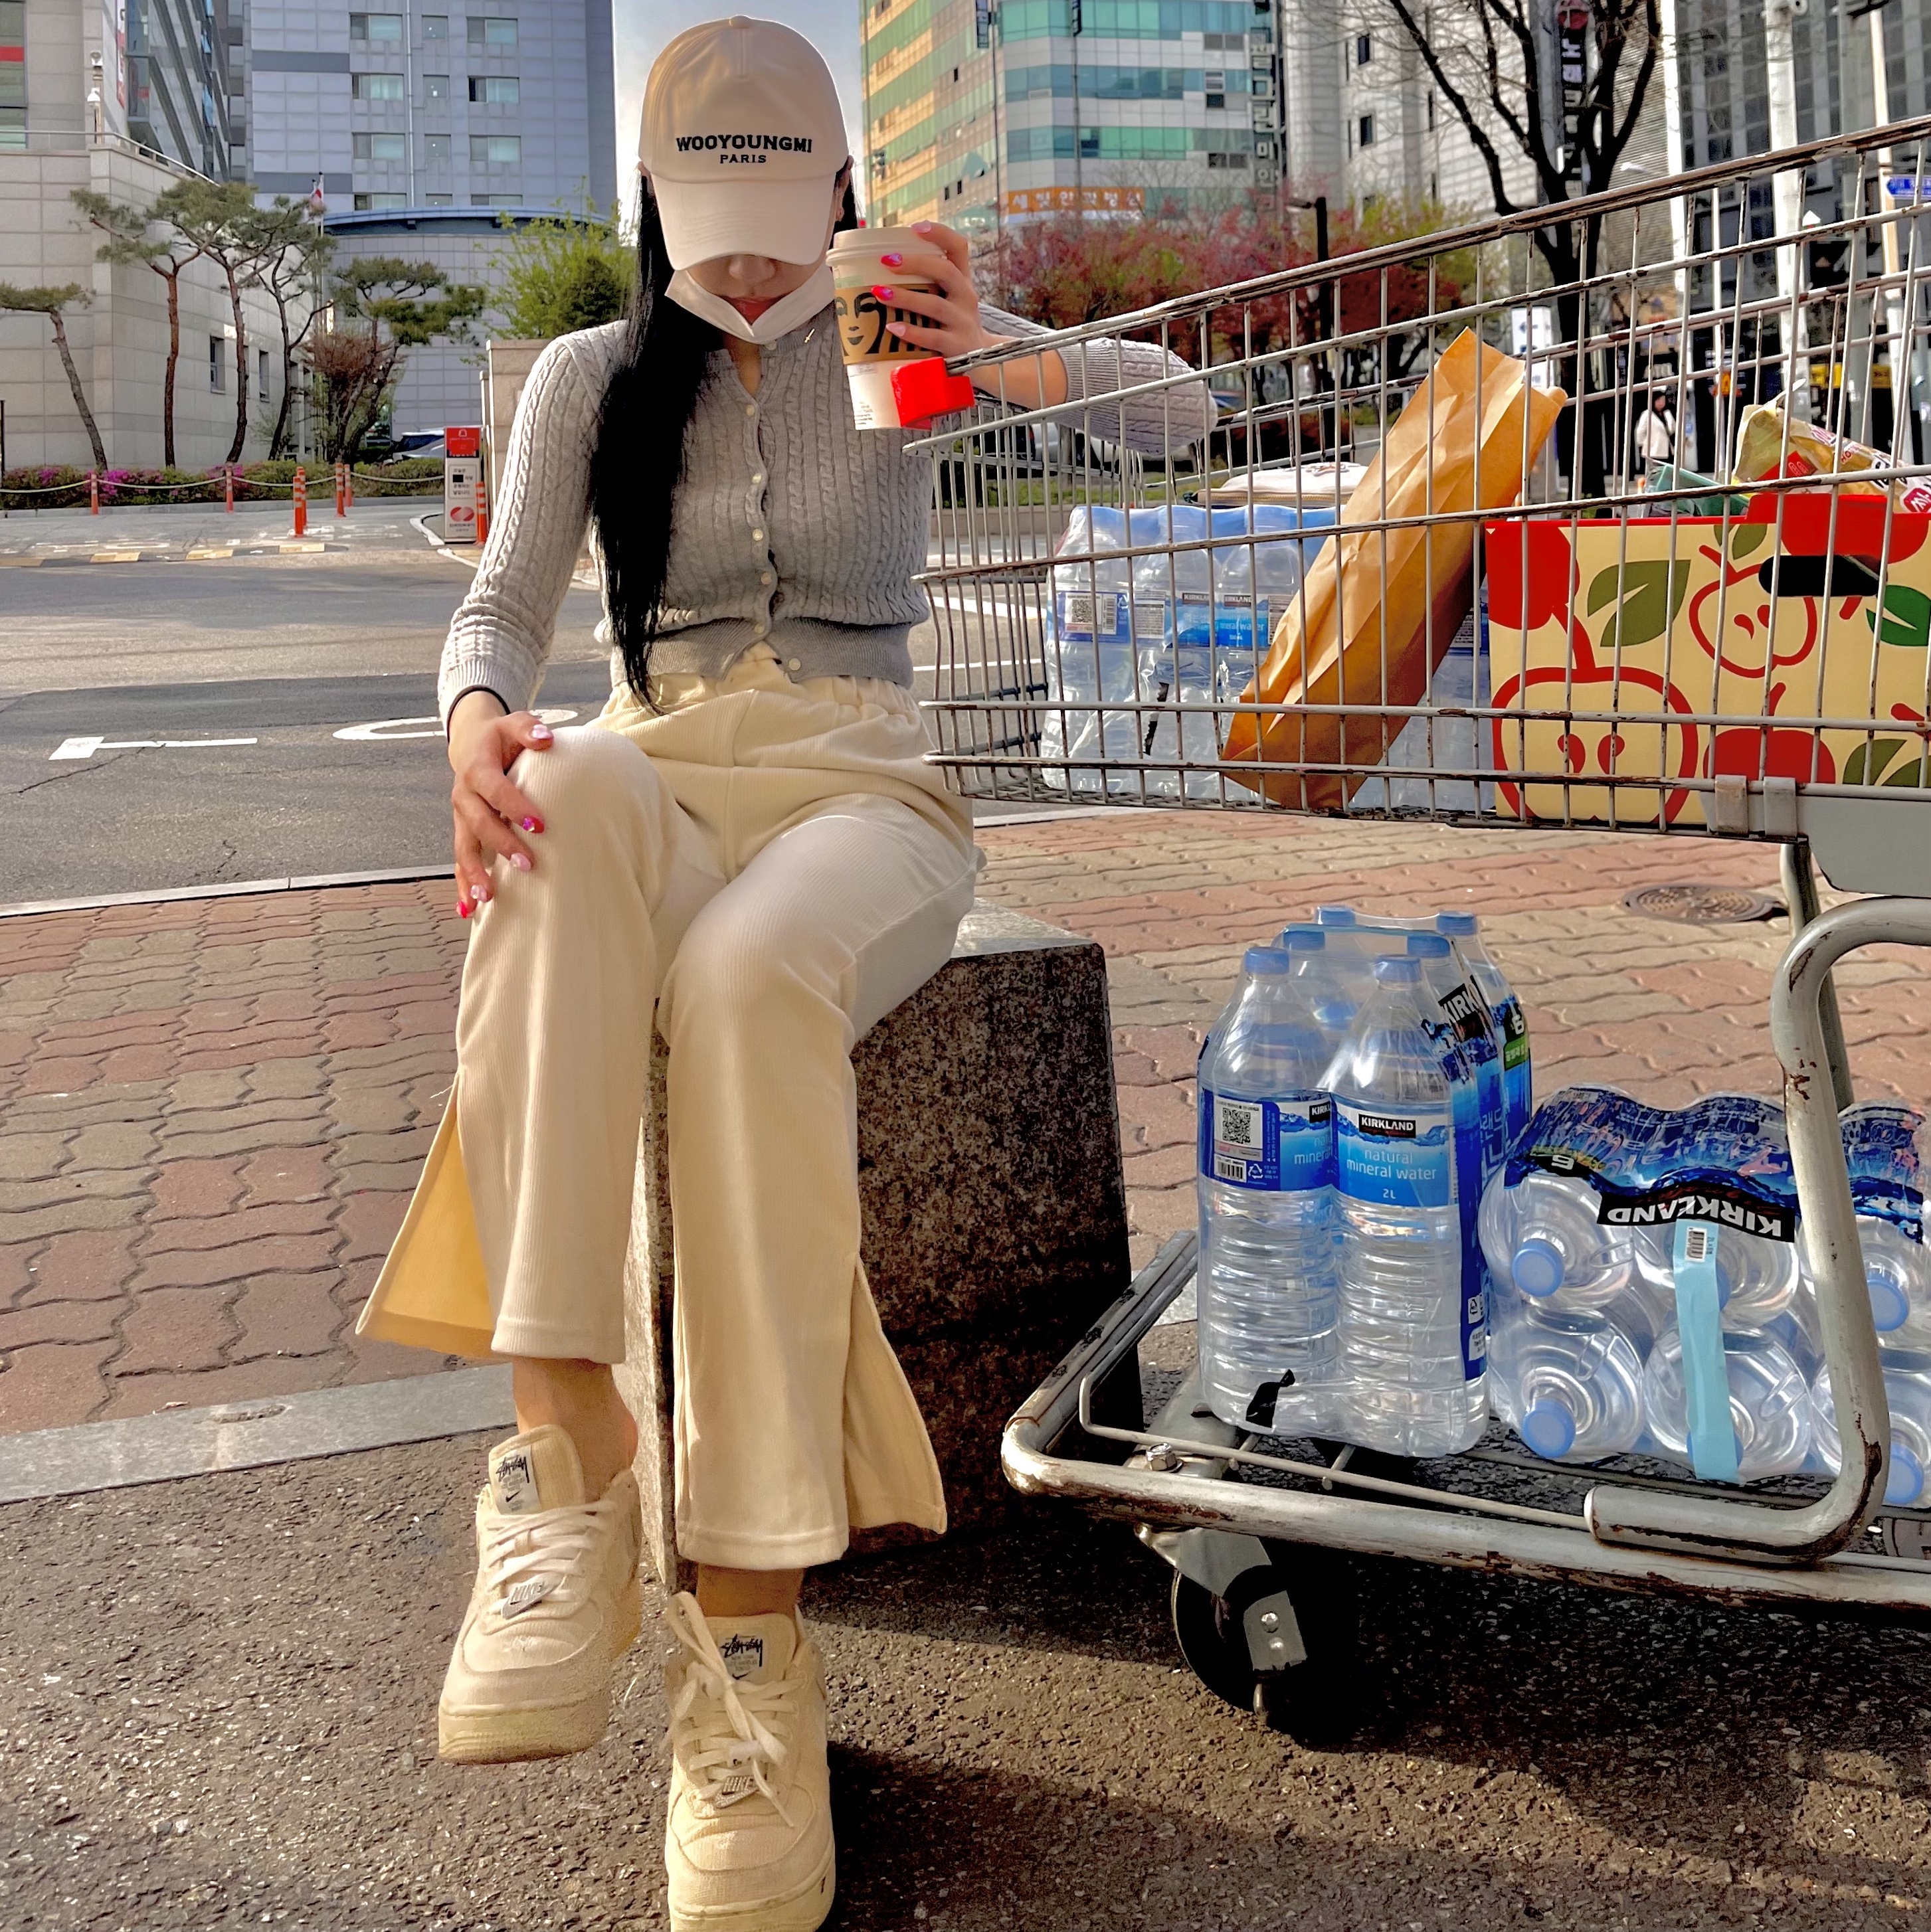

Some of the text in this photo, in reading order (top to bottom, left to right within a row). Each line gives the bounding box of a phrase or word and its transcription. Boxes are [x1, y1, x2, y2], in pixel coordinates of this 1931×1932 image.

[676, 135, 812, 153] WOOYOUNGMI
[720, 154, 767, 163] PARIS
[1361, 1116, 1414, 1131] KIRKLAND
[1364, 1149, 1413, 1164] natural
[1346, 1159, 1436, 1180] mineral water
[1382, 1188, 1396, 1199] 2L
[1607, 1195, 1782, 1237] KIRKLAND
